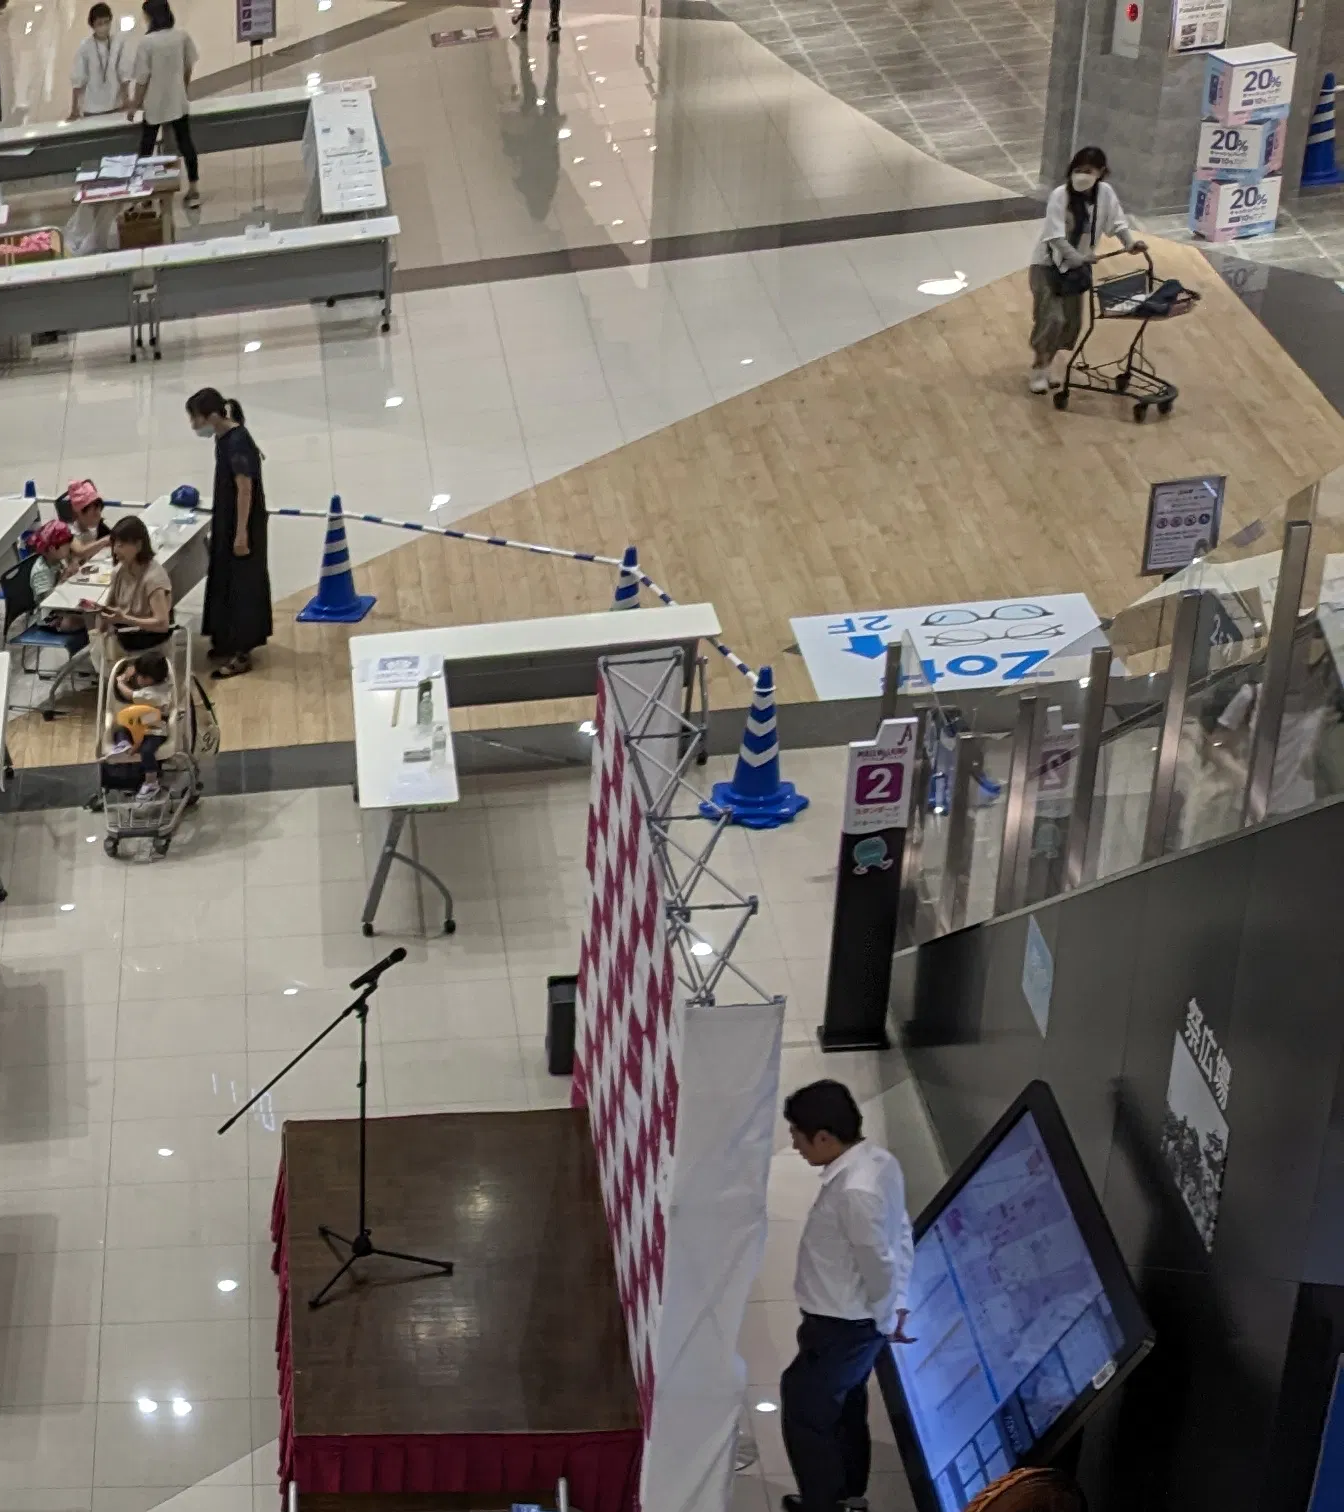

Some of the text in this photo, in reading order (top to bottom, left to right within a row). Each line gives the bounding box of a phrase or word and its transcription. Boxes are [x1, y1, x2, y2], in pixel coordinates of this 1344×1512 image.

[1242, 68, 1282, 93] 20%
[1210, 130, 1249, 151] 20%
[1229, 187, 1268, 210] 20%
[827, 614, 893, 635] 2F
[865, 767, 893, 800] 2
